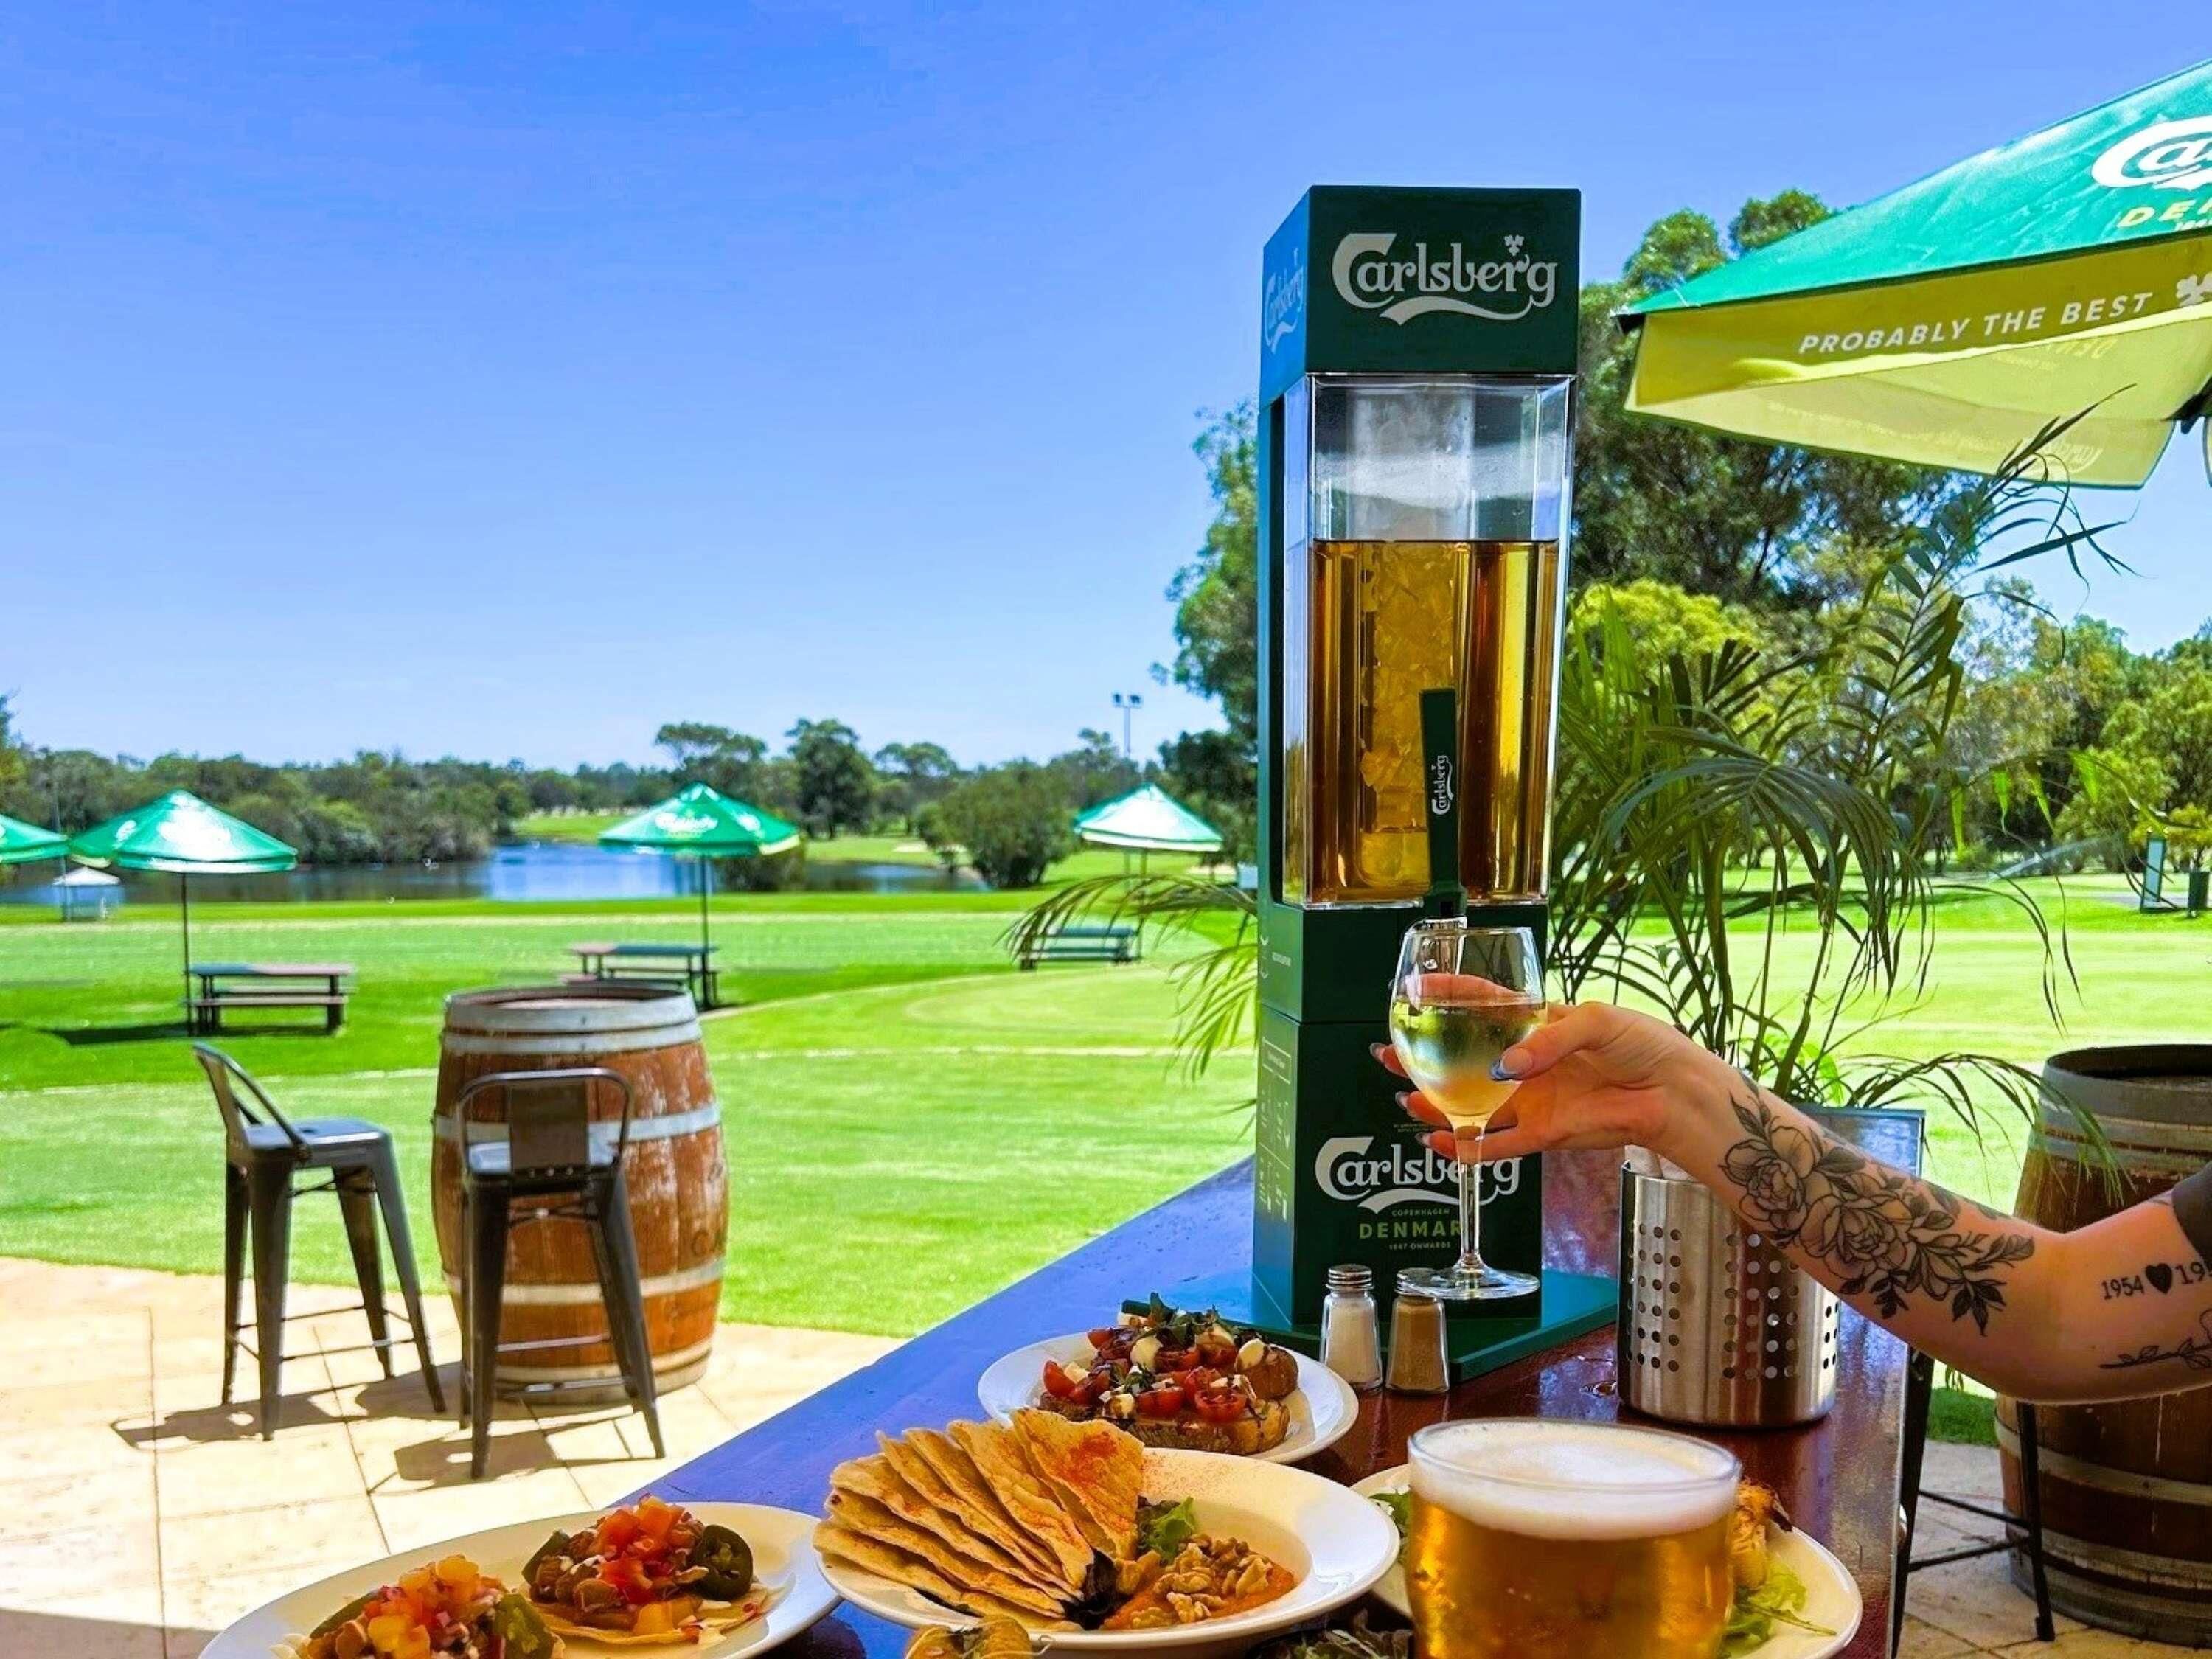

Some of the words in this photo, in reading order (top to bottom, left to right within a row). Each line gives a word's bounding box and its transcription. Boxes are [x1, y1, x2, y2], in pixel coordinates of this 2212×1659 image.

[2091, 115, 2212, 191] Ca
[1332, 233, 1559, 325] Carlsberg
[1799, 317, 1970, 355] PROBABLY
[1983, 305, 2045, 336] THE
[2060, 292, 2154, 325] BEST
[1432, 755, 1454, 815] Carlsberg
[1359, 1220, 1466, 1239] DENMAR
[1392, 1208, 1450, 1217] COPENHAGEN
[2101, 1276, 2145, 1300] 1954
